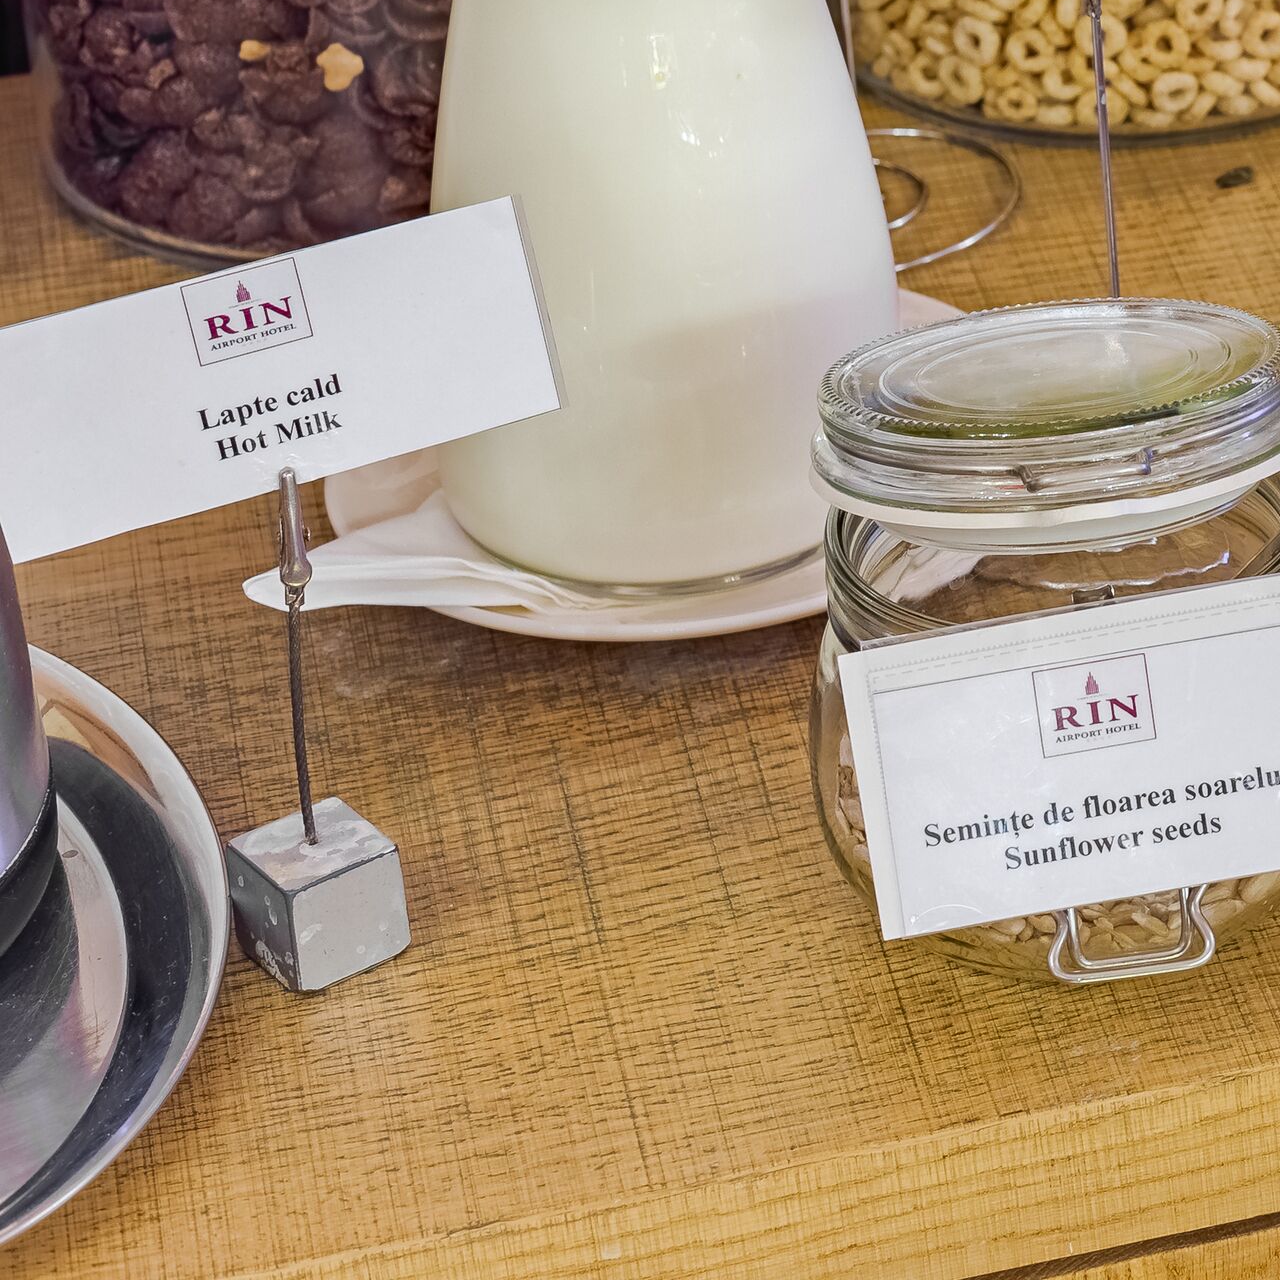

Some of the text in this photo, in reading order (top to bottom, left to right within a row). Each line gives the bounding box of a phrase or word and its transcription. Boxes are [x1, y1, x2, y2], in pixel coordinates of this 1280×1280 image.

[203, 296, 292, 340] RIN
[211, 324, 296, 351] AIRPORT HOTEL
[196, 374, 343, 431] Lapte cald
[215, 410, 343, 462] Hot Milk
[1052, 694, 1139, 732] RIN
[1055, 723, 1142, 743] AIRPORT HOTEL
[923, 809, 1035, 847] Semințe
[1043, 802, 1075, 825] de
[1082, 786, 1177, 819] floarea
[1005, 813, 1222, 870] Sunflower seeds
